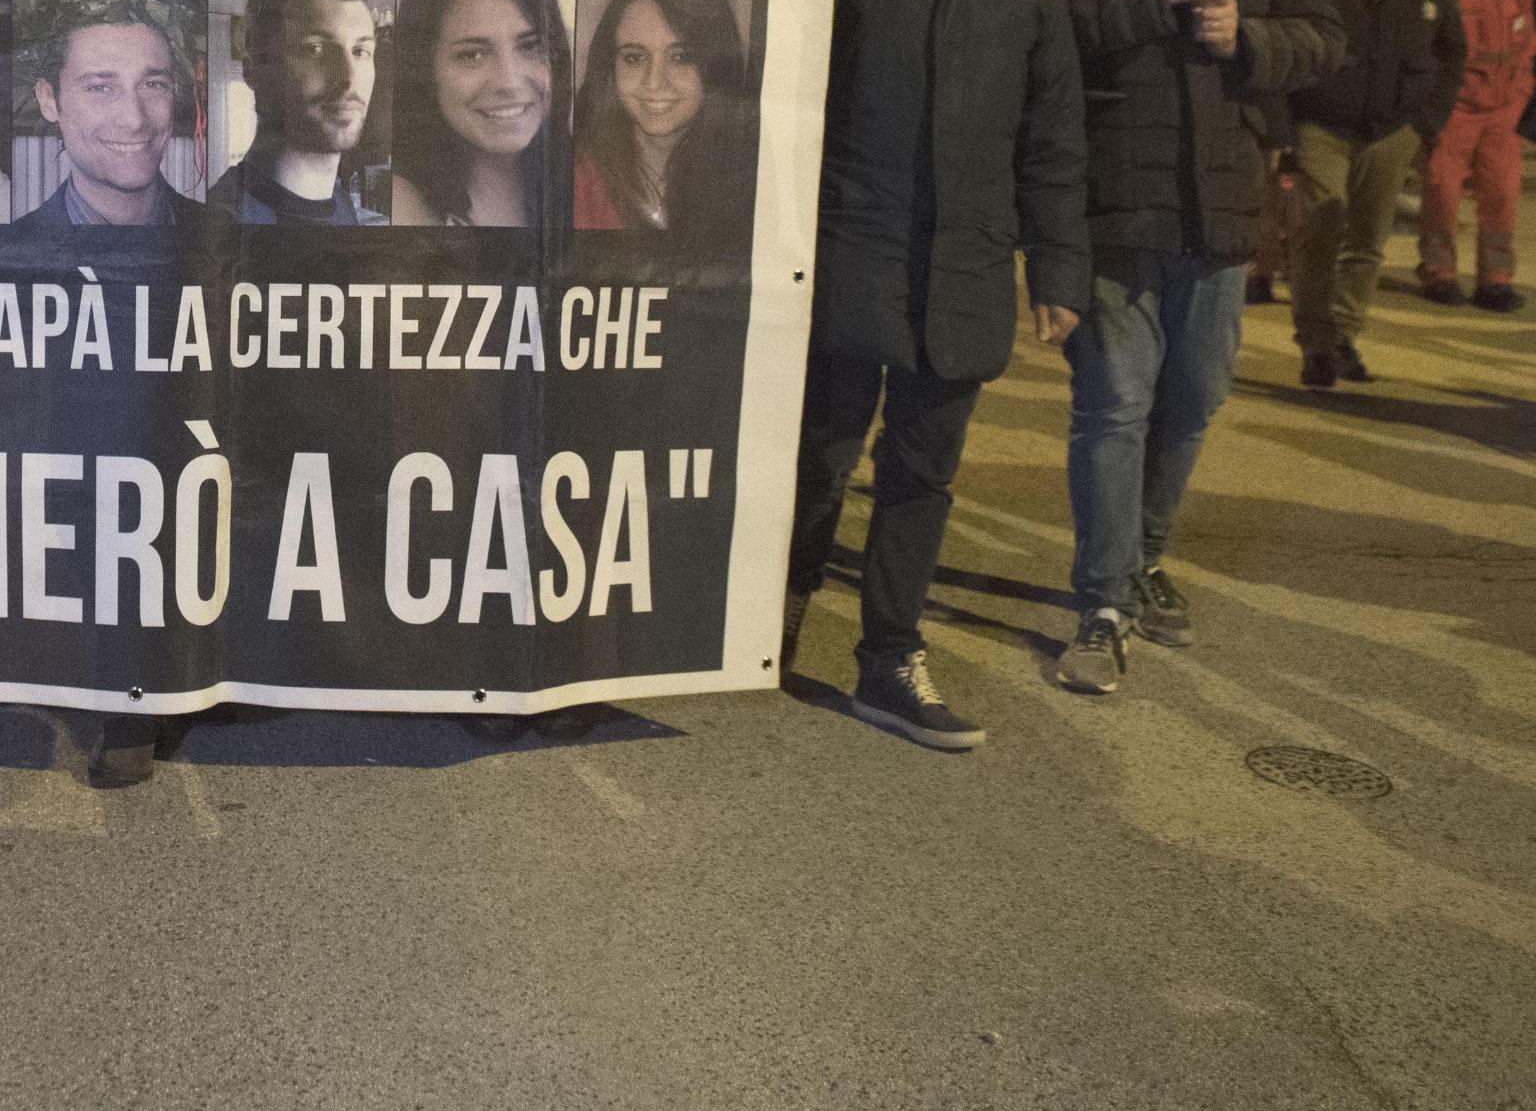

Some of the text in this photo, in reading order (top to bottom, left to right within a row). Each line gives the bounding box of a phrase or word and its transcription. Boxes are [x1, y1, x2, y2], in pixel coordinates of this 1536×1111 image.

[135, 284, 212, 373] LA
[229, 283, 545, 372] CERTEZZA
[559, 286, 668, 370] CHE
[267, 452, 346, 622] A
[384, 448, 713, 626] CASA"
